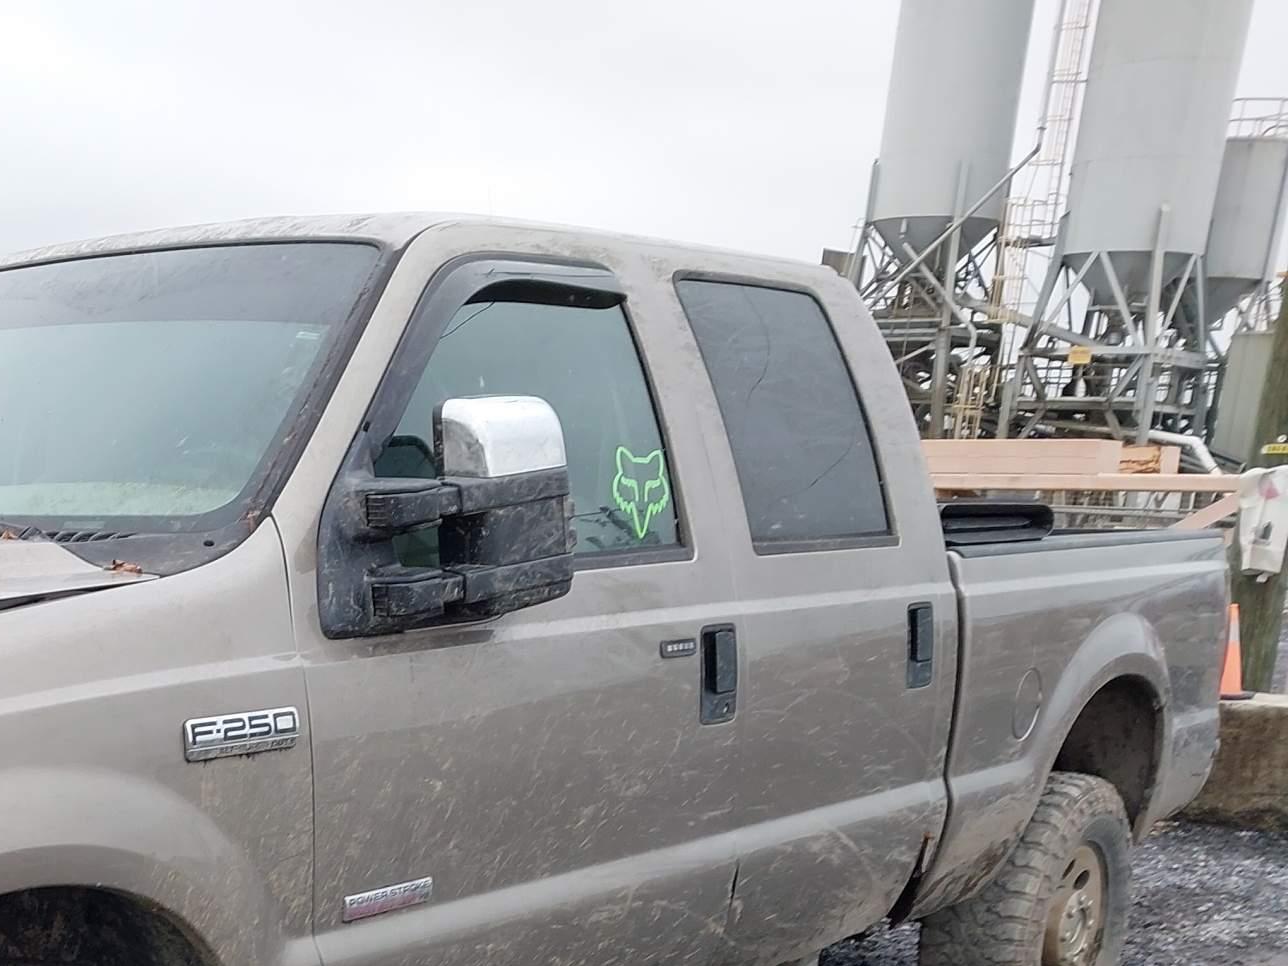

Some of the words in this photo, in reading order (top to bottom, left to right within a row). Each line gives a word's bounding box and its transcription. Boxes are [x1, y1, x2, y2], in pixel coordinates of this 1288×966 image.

[190, 710, 297, 746] F-250
[348, 891, 388, 908] POWER
[388, 879, 433, 898] STROKE
